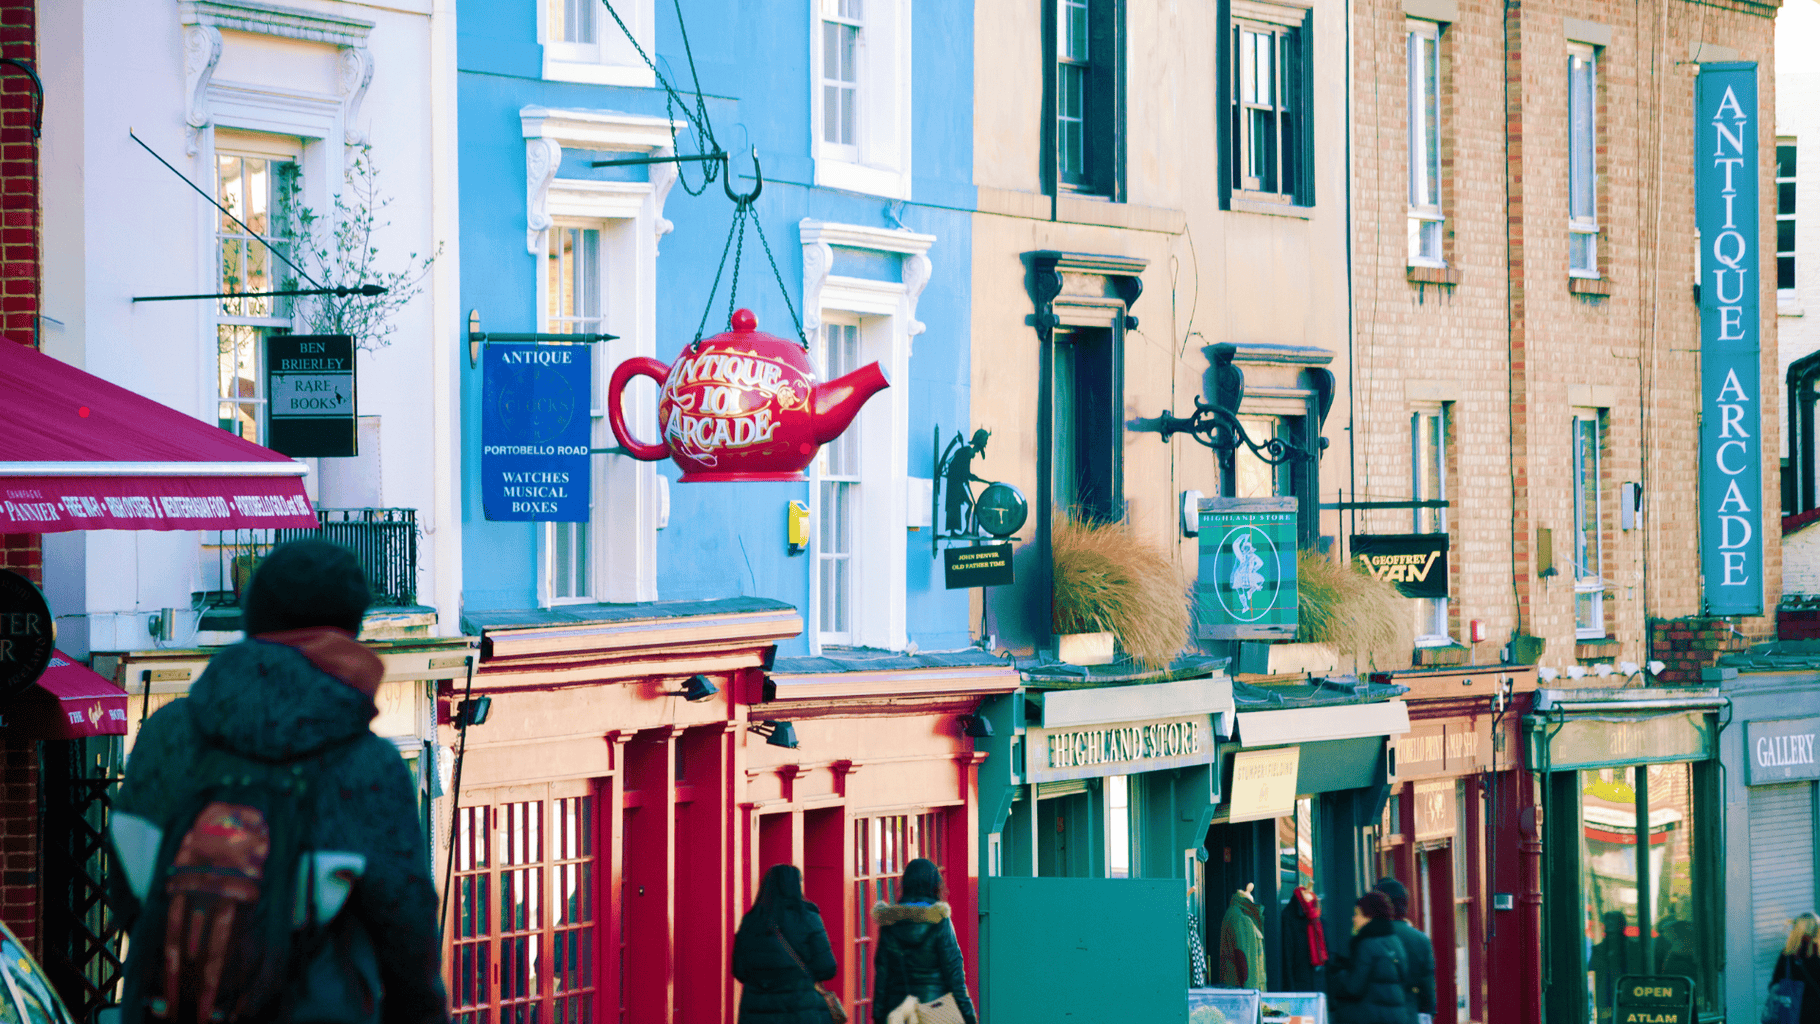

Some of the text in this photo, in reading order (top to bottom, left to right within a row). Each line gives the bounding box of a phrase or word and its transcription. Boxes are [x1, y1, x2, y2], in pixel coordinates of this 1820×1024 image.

[1711, 84, 1748, 341] ANTIQUE
[300, 342, 326, 354] BEN
[281, 358, 344, 370] BRIERLEY
[501, 351, 572, 366] ANTIQUE
[661, 348, 788, 400] ANTIQUE
[295, 379, 332, 392] RARE
[290, 397, 337, 410] BOOKS
[664, 404, 780, 450] ARCADE
[484, 445, 588, 456] PORTOBELLO ROAD
[502, 471, 569, 484] WATCHES
[1716, 367, 1751, 586] ARCADE
[503, 486, 568, 498] MUSICAL
[4, 500, 61, 521] PANNIER
[511, 501, 558, 513] BOXES
[1359, 551, 1440, 582] VAN
[1372, 554, 1428, 566] GEOFFREY
[1054, 721, 1199, 768] HIGHLAND STORE
[1756, 733, 1816, 767] GALLERY
[1633, 986, 1673, 998] OPEN
[1627, 1013, 1678, 1023] ATLAM
